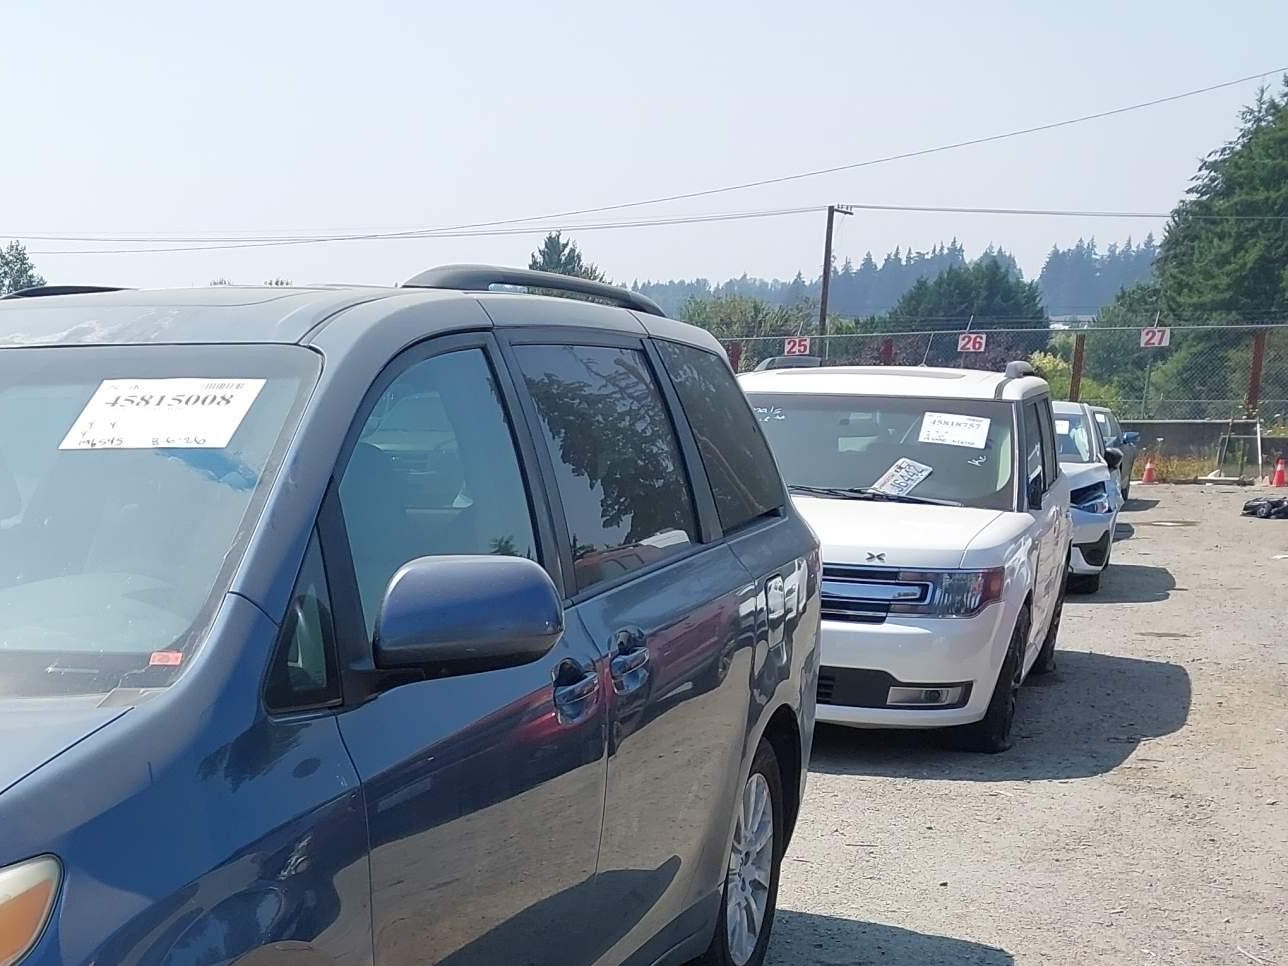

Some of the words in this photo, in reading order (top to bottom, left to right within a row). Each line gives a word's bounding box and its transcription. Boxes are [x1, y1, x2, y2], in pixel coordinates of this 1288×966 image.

[960, 335, 984, 351] 26
[1144, 330, 1166, 346] 27
[787, 339, 807, 354] 25
[104, 393, 234, 407] 45815008
